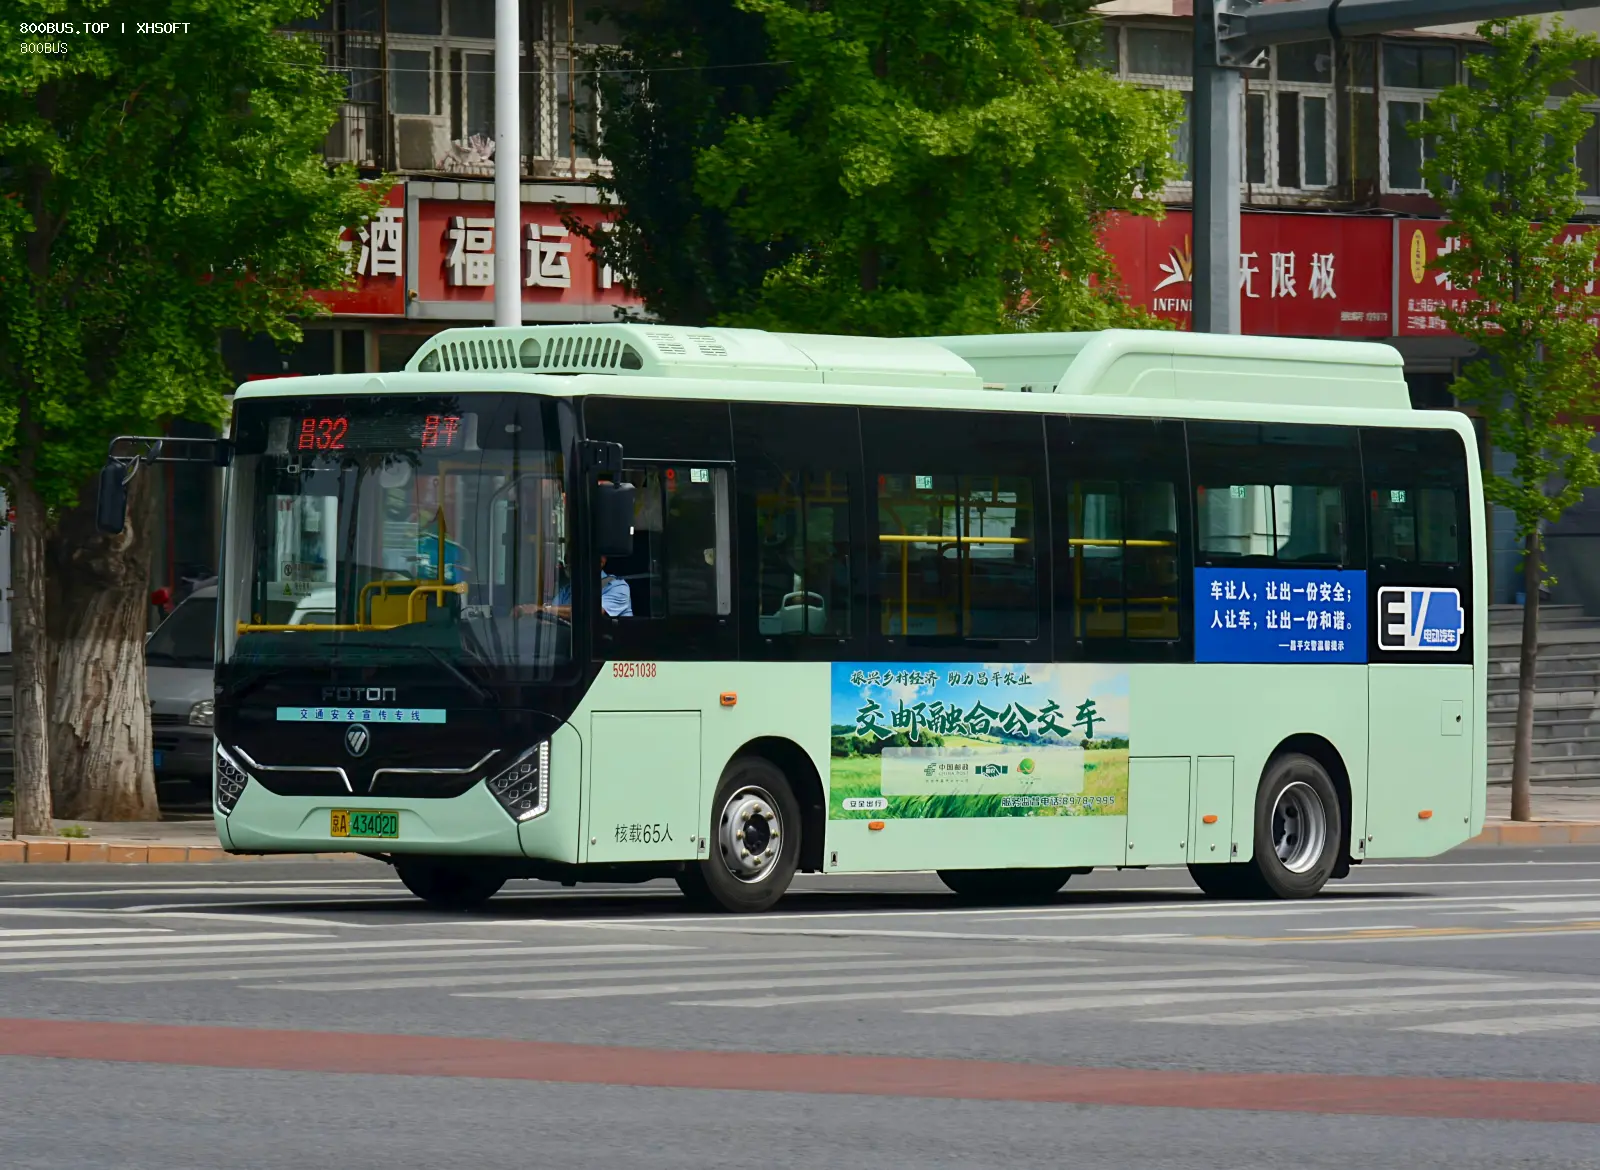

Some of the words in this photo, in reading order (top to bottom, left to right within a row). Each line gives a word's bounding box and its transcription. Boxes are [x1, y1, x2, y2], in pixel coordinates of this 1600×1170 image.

[339, 207, 404, 276] 酒
[449, 216, 642, 289] 福运
[1240, 251, 1337, 299] 无限极
[1153, 298, 1192, 312] INFINI
[422, 415, 460, 448] 昌平
[1424, 628, 1456, 643] 电动汽车
[613, 663, 657, 678] 59251038
[850, 670, 938, 687] 振兴乡村经济
[947, 671, 1033, 687] 助力昌平农业
[322, 687, 396, 701] FOTON
[300, 708, 420, 721] 交通安全宣传专线
[855, 698, 1106, 742] 交邮融合公交车
[939, 763, 969, 771] 中国邮政
[850, 800, 882, 808] 安全出行
[614, 823, 673, 844] 核载65人
